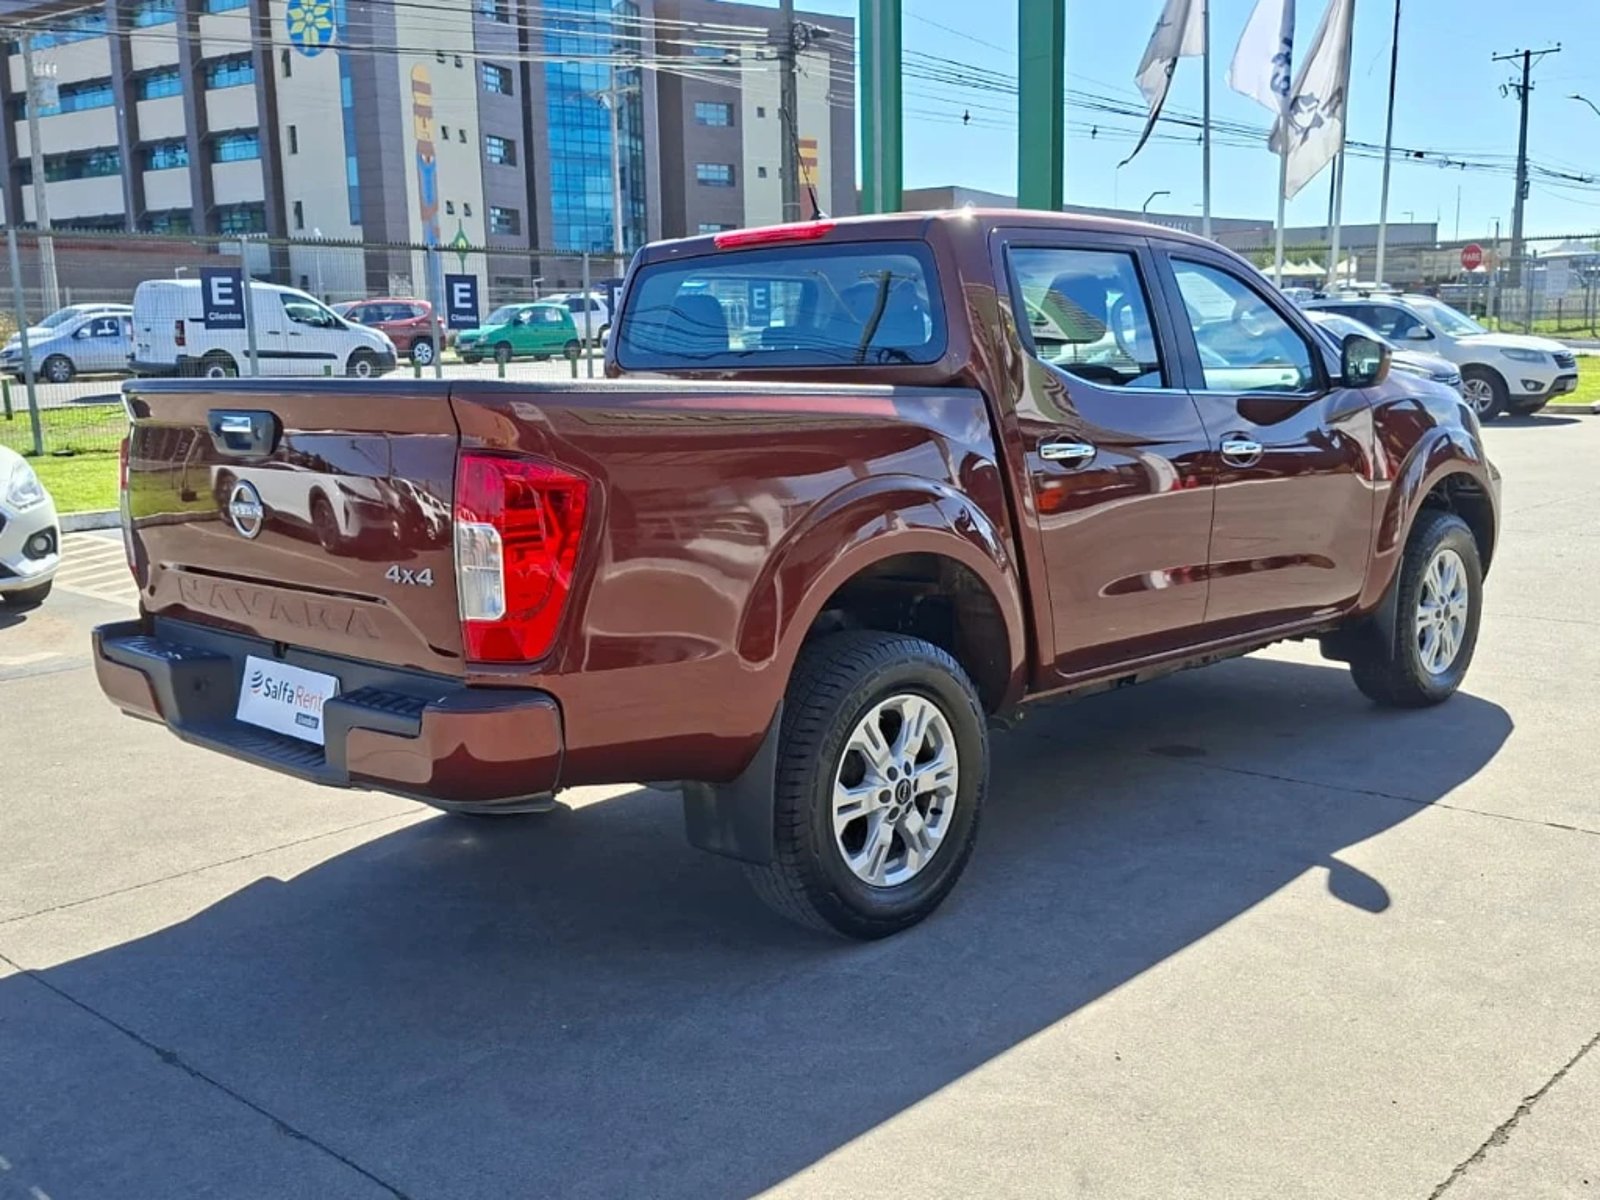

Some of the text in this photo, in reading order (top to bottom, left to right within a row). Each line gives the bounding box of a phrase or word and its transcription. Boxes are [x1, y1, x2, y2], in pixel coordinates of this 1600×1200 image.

[211, 277, 235, 305] E
[454, 283, 472, 308] E
[753, 288, 766, 309] E
[208, 311, 242, 320] Clientes
[384, 564, 434, 587] 4x4
[178, 576, 381, 640] NAVARA
[263, 677, 324, 712] SalfaRent
